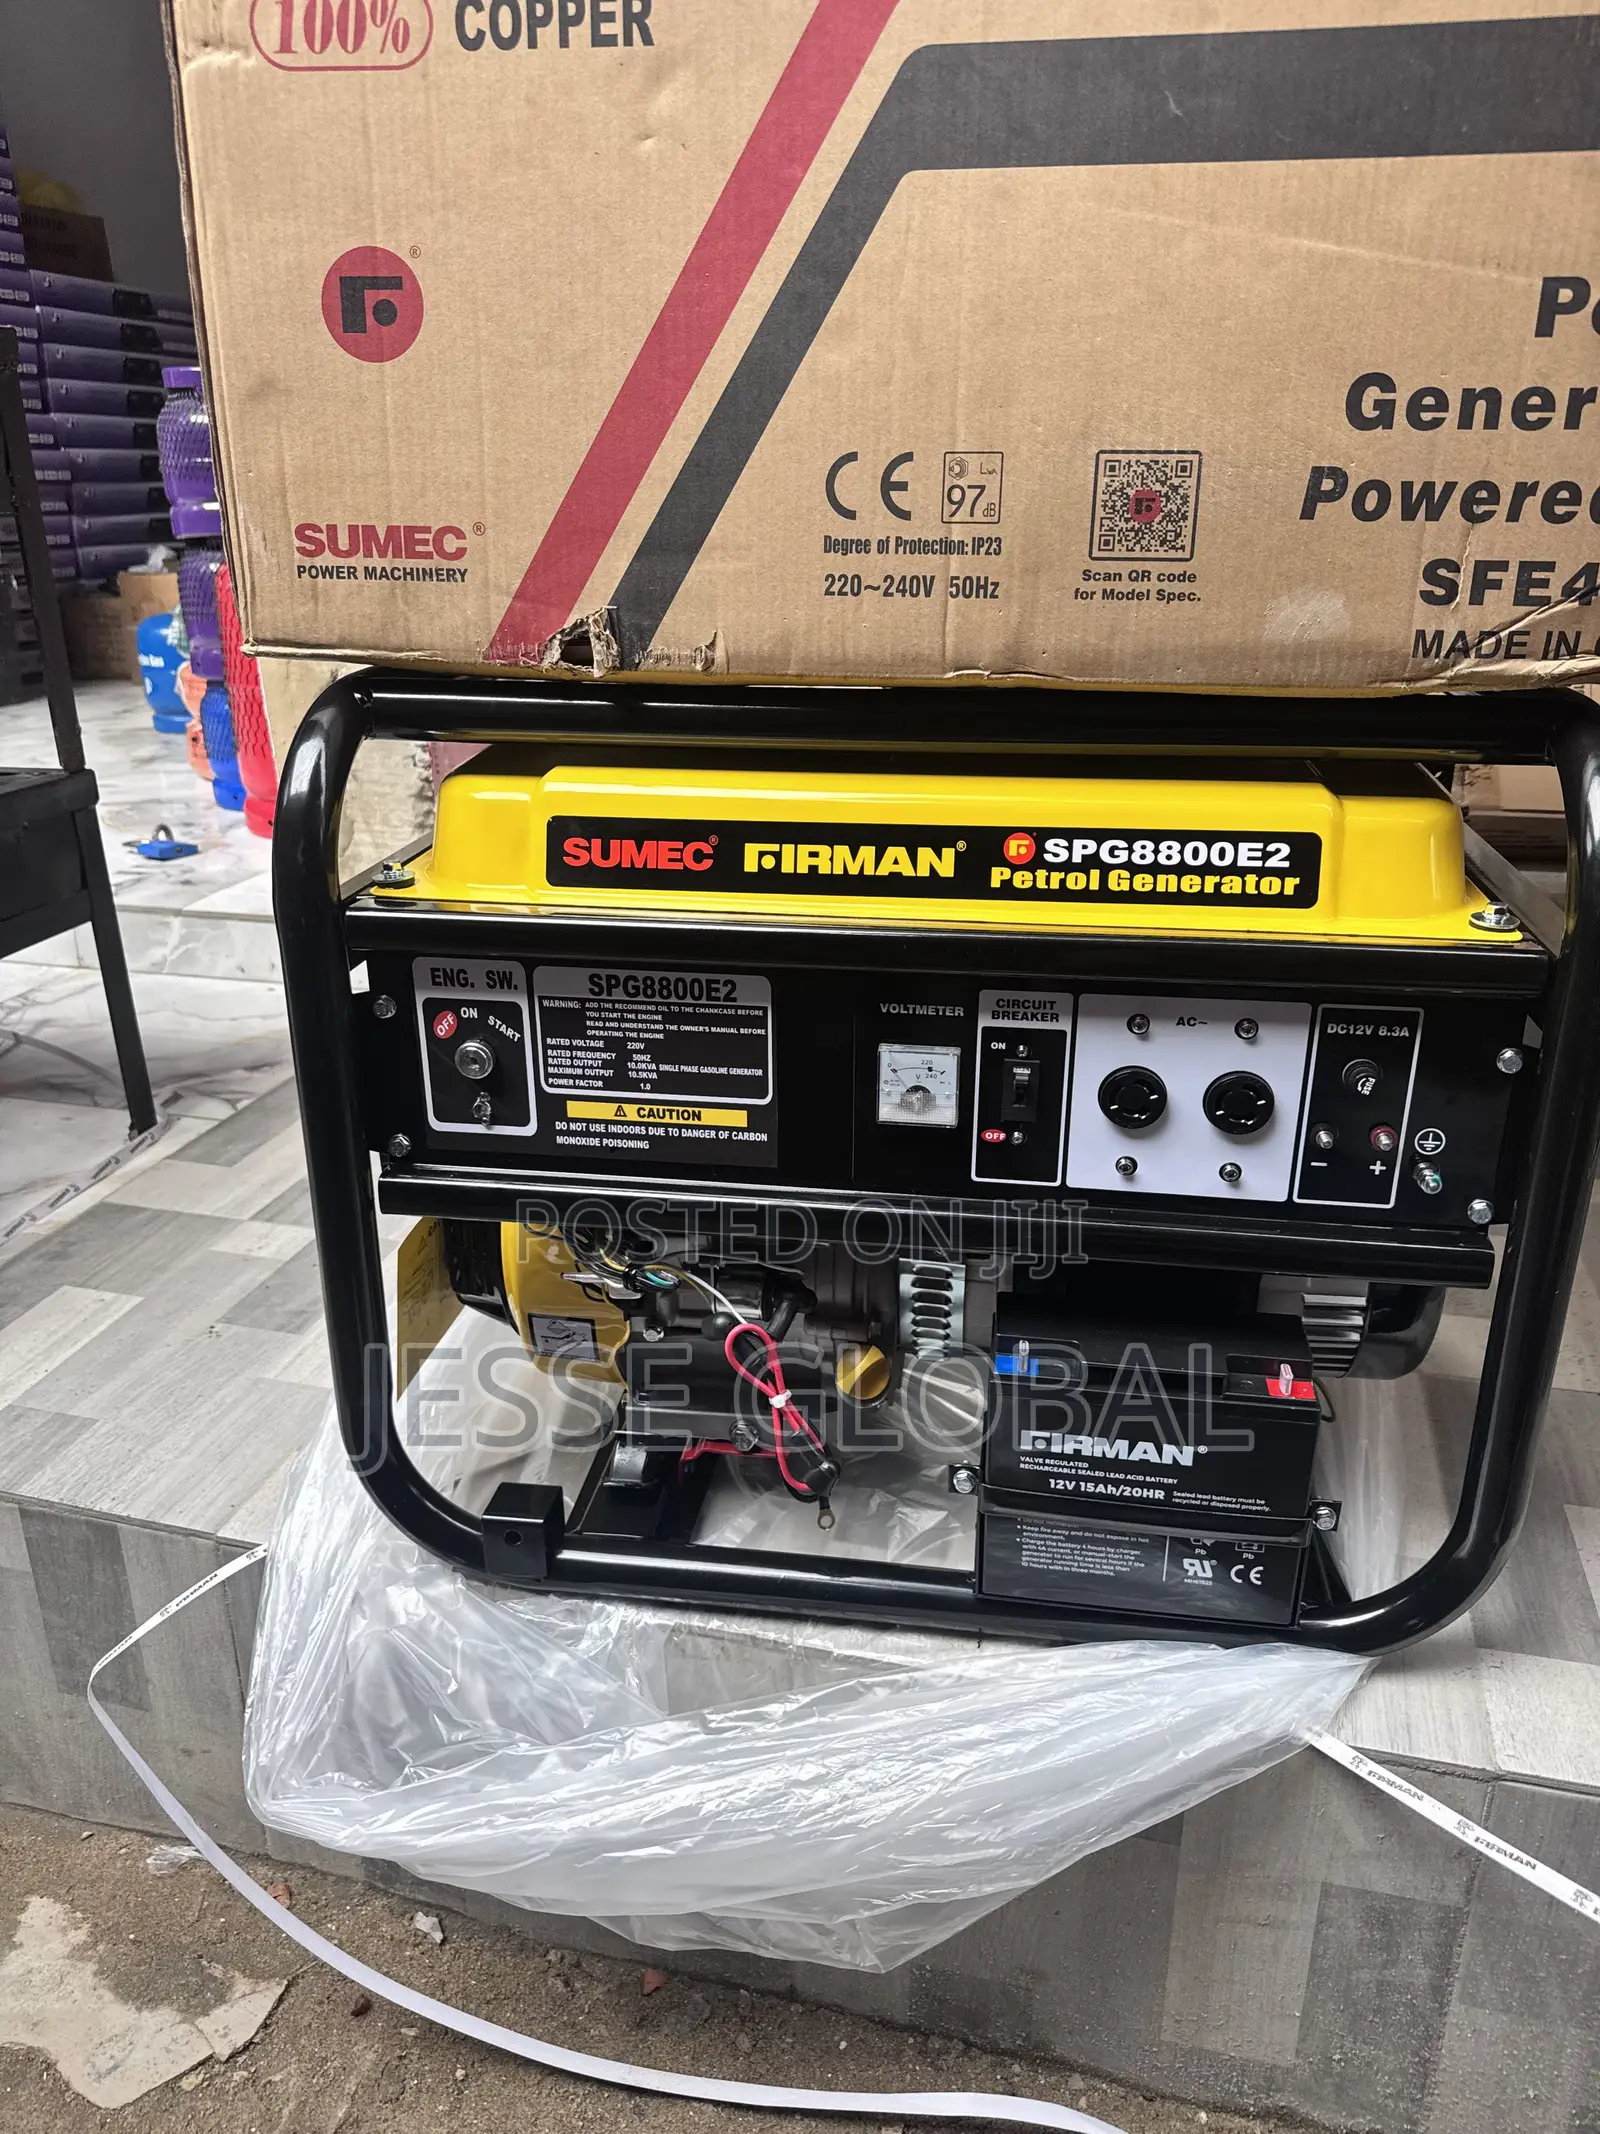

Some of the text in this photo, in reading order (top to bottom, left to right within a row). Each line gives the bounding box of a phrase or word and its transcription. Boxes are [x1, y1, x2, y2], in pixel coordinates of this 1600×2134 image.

[274, 0, 655, 55] 100% COPPER
[1534, 276, 1600, 338] P
[1345, 372, 1598, 432] Gener
[946, 484, 997, 518] 97 dB
[1299, 465, 1600, 525] Powere
[823, 535, 1003, 556] Degree of Protection: IP23
[296, 565, 469, 583] POWER MACHINERY
[1082, 569, 1197, 583] Scan QR code
[823, 573, 1000, 599] 220~240V 50Hz
[1074, 588, 1201, 604] for Model Spec.
[1411, 629, 1531, 660] MADE
[1541, 630, 1581, 661] IN
[1043, 838, 1291, 868] SPG8800E2
[990, 867, 1300, 896] Petrol Generator
[429, 967, 519, 991] ENG. SW.
[588, 973, 738, 1003] SPG8800E2
[542, 999, 582, 1009] WARNING:
[614, 1003, 656, 1011] RECOMMEND
[879, 1003, 965, 1017] VOLTMETER
[995, 998, 1057, 1010] CIRCUIT
[460, 1006, 478, 1019] ON
[637, 1013, 663, 1021] ENGINE
[991, 1011, 1060, 1023] BREAKER
[436, 1013, 455, 1037] OFF
[487, 1015, 521, 1042] START
[620, 1022, 664, 1030] UNDERSTAND
[679, 1024, 710, 1032] OWNER'S
[710, 1026, 739, 1034] MANUAL
[1327, 1023, 1410, 1037] DC12V 8.3A
[586, 1029, 624, 1038] OPERATING
[546, 1037, 645, 1050] RATED VOLTAGE 220V
[990, 1042, 1006, 1050] ON
[547, 1049, 651, 1061] RATED FREQUENCY 50HZ
[548, 1057, 763, 1076] RATED OUTPUT 10.0KVA SINGLE PHASE GASOLINE GENERATOR
[548, 1066, 658, 1080] MAXIMUM OUTPUT 10.5KVA
[548, 1077, 574, 1086] POWER
[575, 1078, 604, 1088] FACTOR
[1361, 1077, 1376, 1096] FUSE
[636, 1106, 702, 1122] CAUTION
[555, 1121, 768, 1142] DO NOT USE INDOORS DUE TO DANGER OF CARBON
[985, 1132, 1006, 1140] OFF
[556, 1135, 650, 1149] MONOXIDE POISONING
[1020, 1456, 1089, 1468] VALVE REGULATED
[1019, 1463, 1178, 1485] RECHARGEABLE SEALED LEAD ACID BATTERY
[1049, 1478, 1166, 1500] 12V 15Ah/20HR
[1173, 1491, 1195, 1499] Sealed
[1196, 1492, 1211, 1500] lead
[1212, 1494, 1236, 1503] battery
[1172, 1497, 1201, 1506] recycled
[1210, 1501, 1240, 1510] disposed
[1241, 1503, 1272, 1512] properly.
[1022, 1537, 1045, 1545] Charge
[1058, 1541, 1081, 1549] battery
[1116, 1547, 1141, 1555] charger
[1242, 1552, 1255, 1560] Pb
